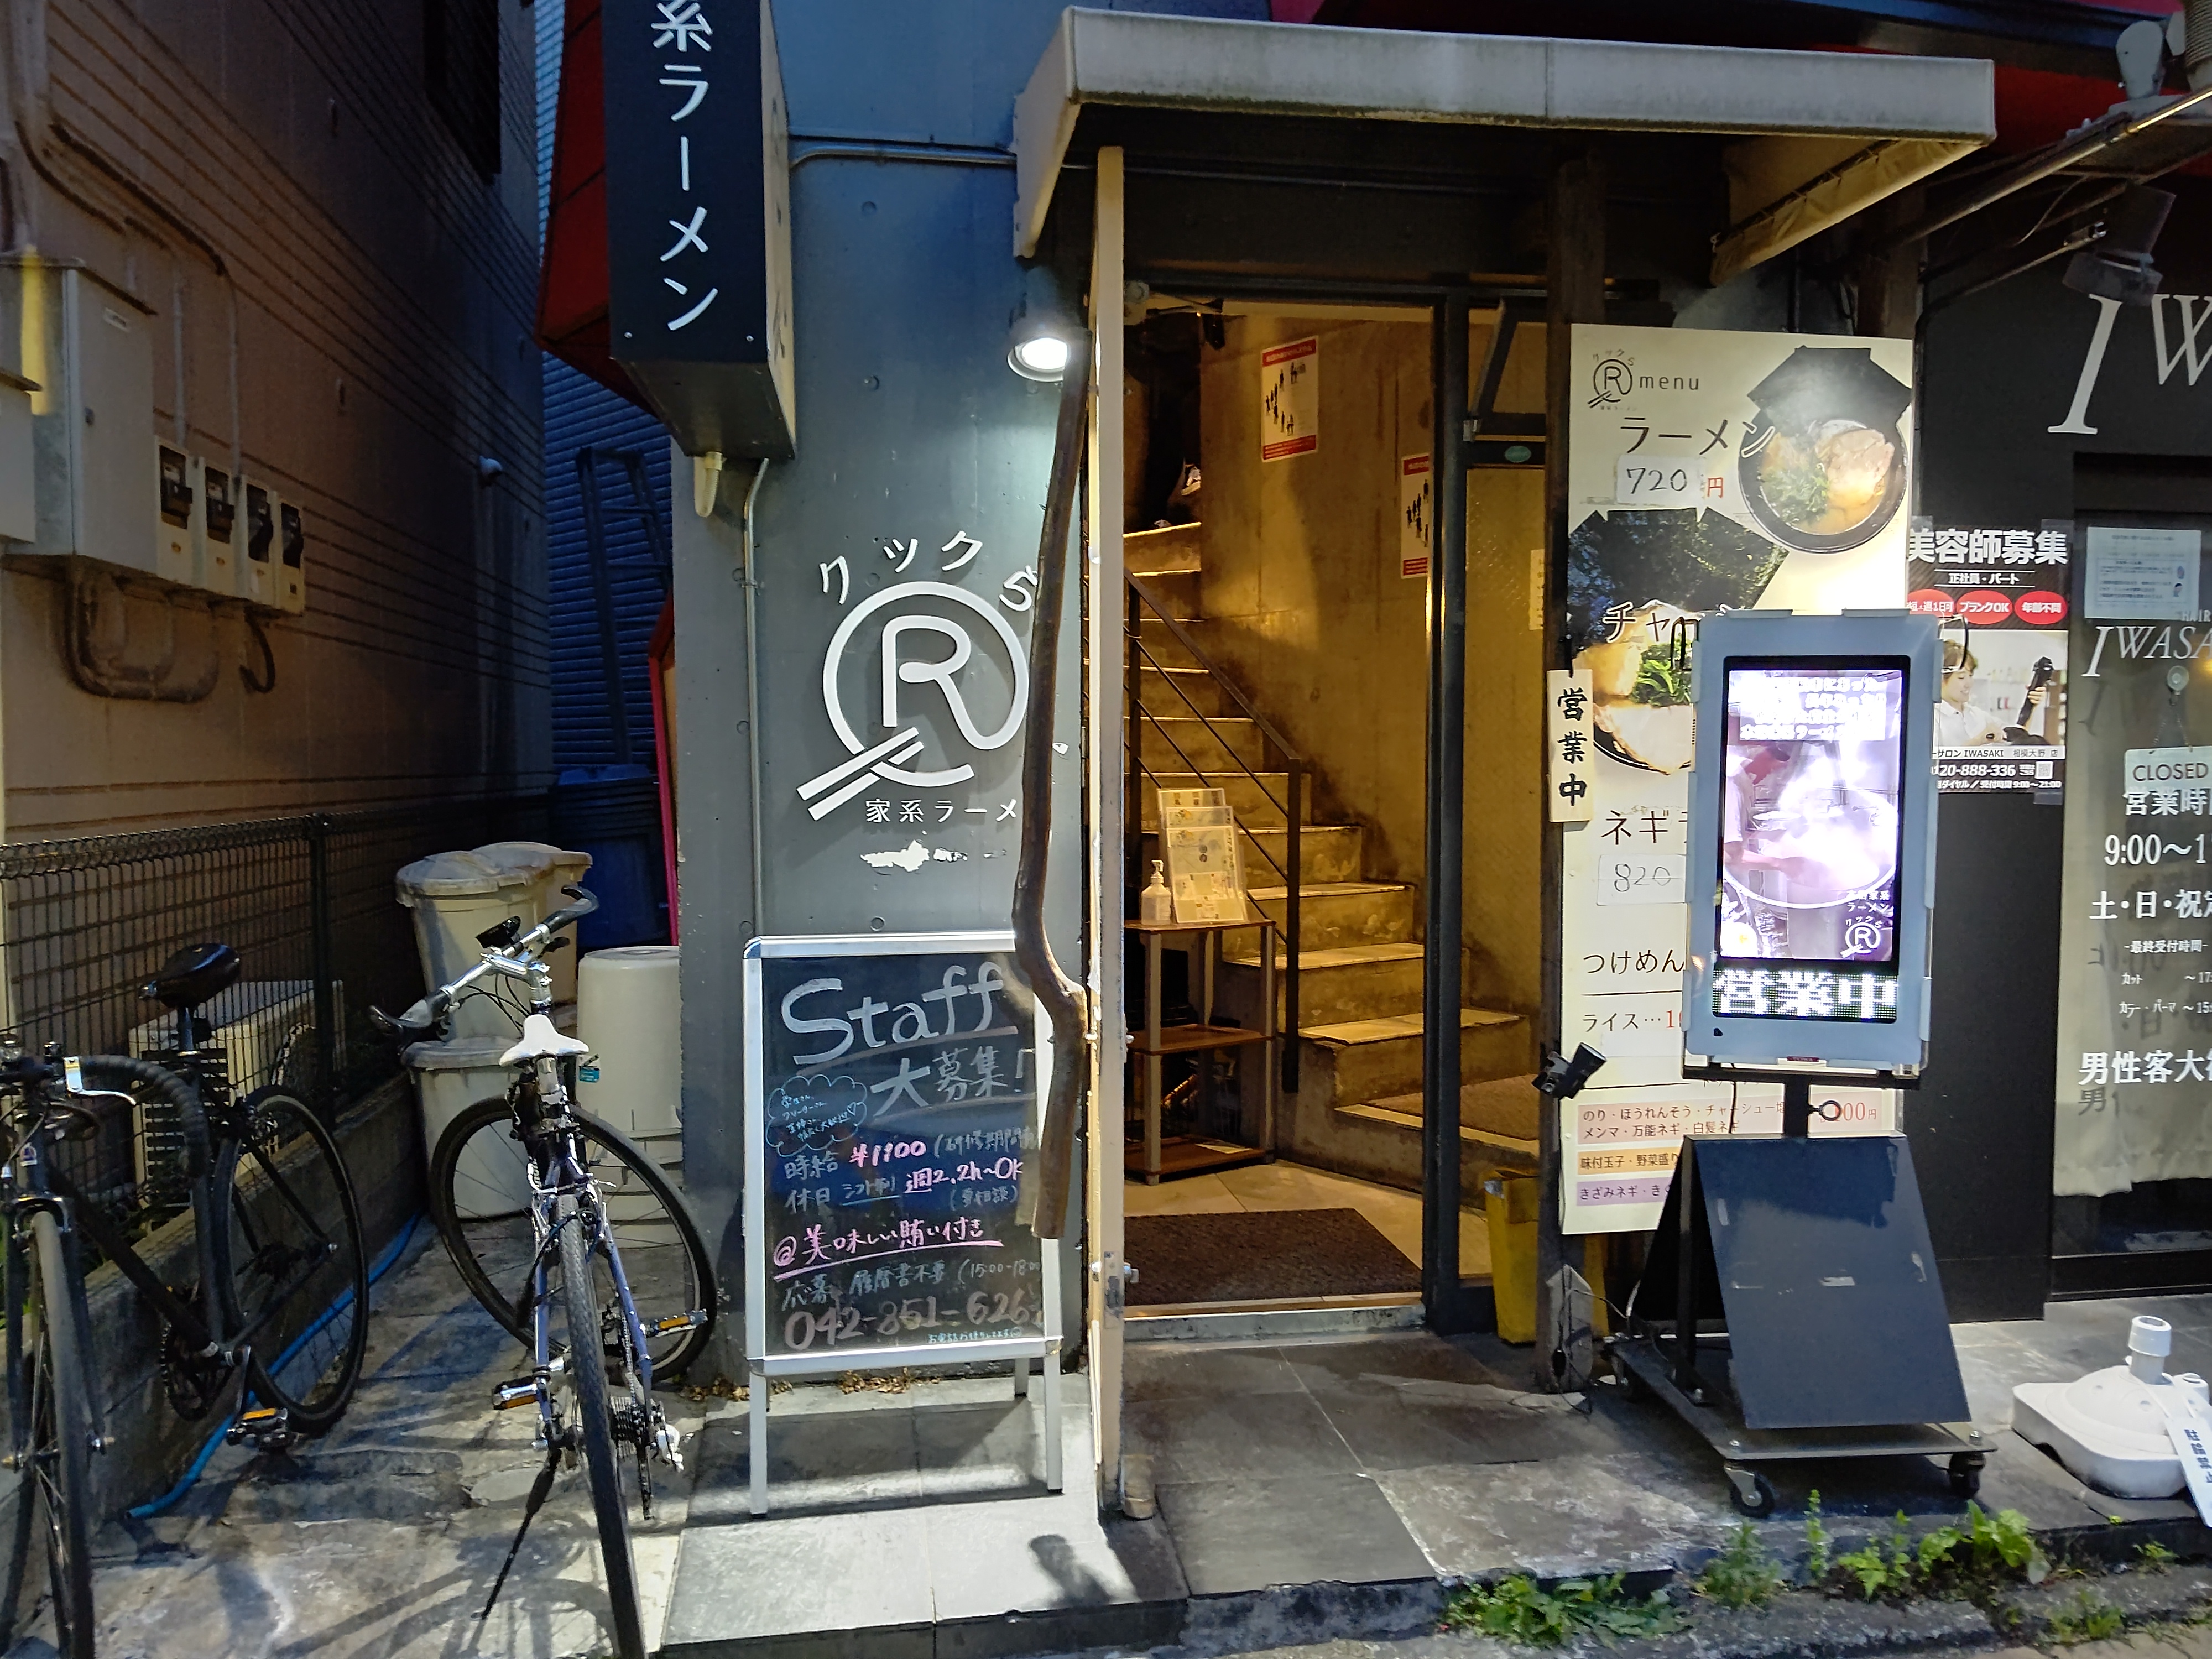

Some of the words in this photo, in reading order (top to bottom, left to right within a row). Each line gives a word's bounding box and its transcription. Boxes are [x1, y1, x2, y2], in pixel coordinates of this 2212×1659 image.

[651, 0, 718, 331] 系ラーメン
[1639, 375, 1699, 390] menu
[1620, 417, 1776, 458] ラーメン
[1626, 467, 1688, 494] 720
[1707, 476, 1724, 498] 円
[1908, 528, 2069, 565] 美容師募集
[1959, 602, 2010, 613] ブランクOK
[2021, 602, 2062, 613] 年齢不問
[1557, 687, 1589, 807] 営業中
[1932, 749, 1961, 758] サロン
[1964, 749, 2004, 758] IWASAKI
[2013, 749, 2046, 758] 相模大野
[2050, 749, 2058, 758] 店
[2133, 763, 2209, 781] CLOSED
[865, 798, 1018, 823] 家系ラーメ
[2122, 787, 2212, 816] 営業時
[1613, 863, 1672, 892] 820
[1847, 902, 1890, 912] ラーメン
[2089, 889, 2212, 919] 土・日・祝
[1583, 949, 1684, 975] つけめん
[781, 961, 1002, 1065] Staff
[2078, 1050, 2212, 1086] 男性客大
[784, 1150, 839, 1180] 時給
